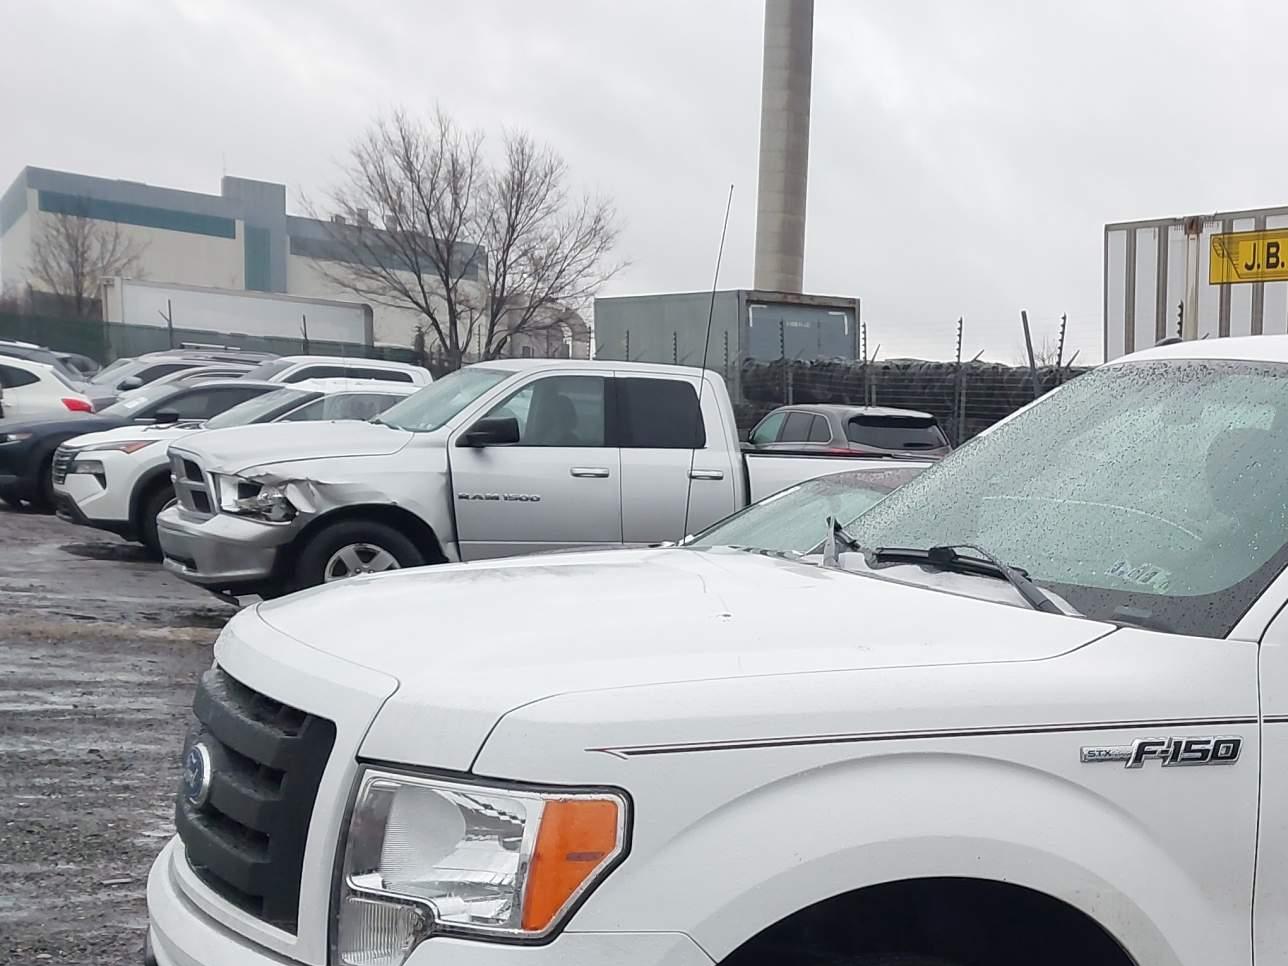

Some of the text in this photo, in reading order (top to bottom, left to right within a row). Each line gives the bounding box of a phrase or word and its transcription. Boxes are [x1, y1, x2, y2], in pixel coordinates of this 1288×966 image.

[457, 492, 541, 502] RAM 1500
[1087, 737, 1243, 767] STX F-150
